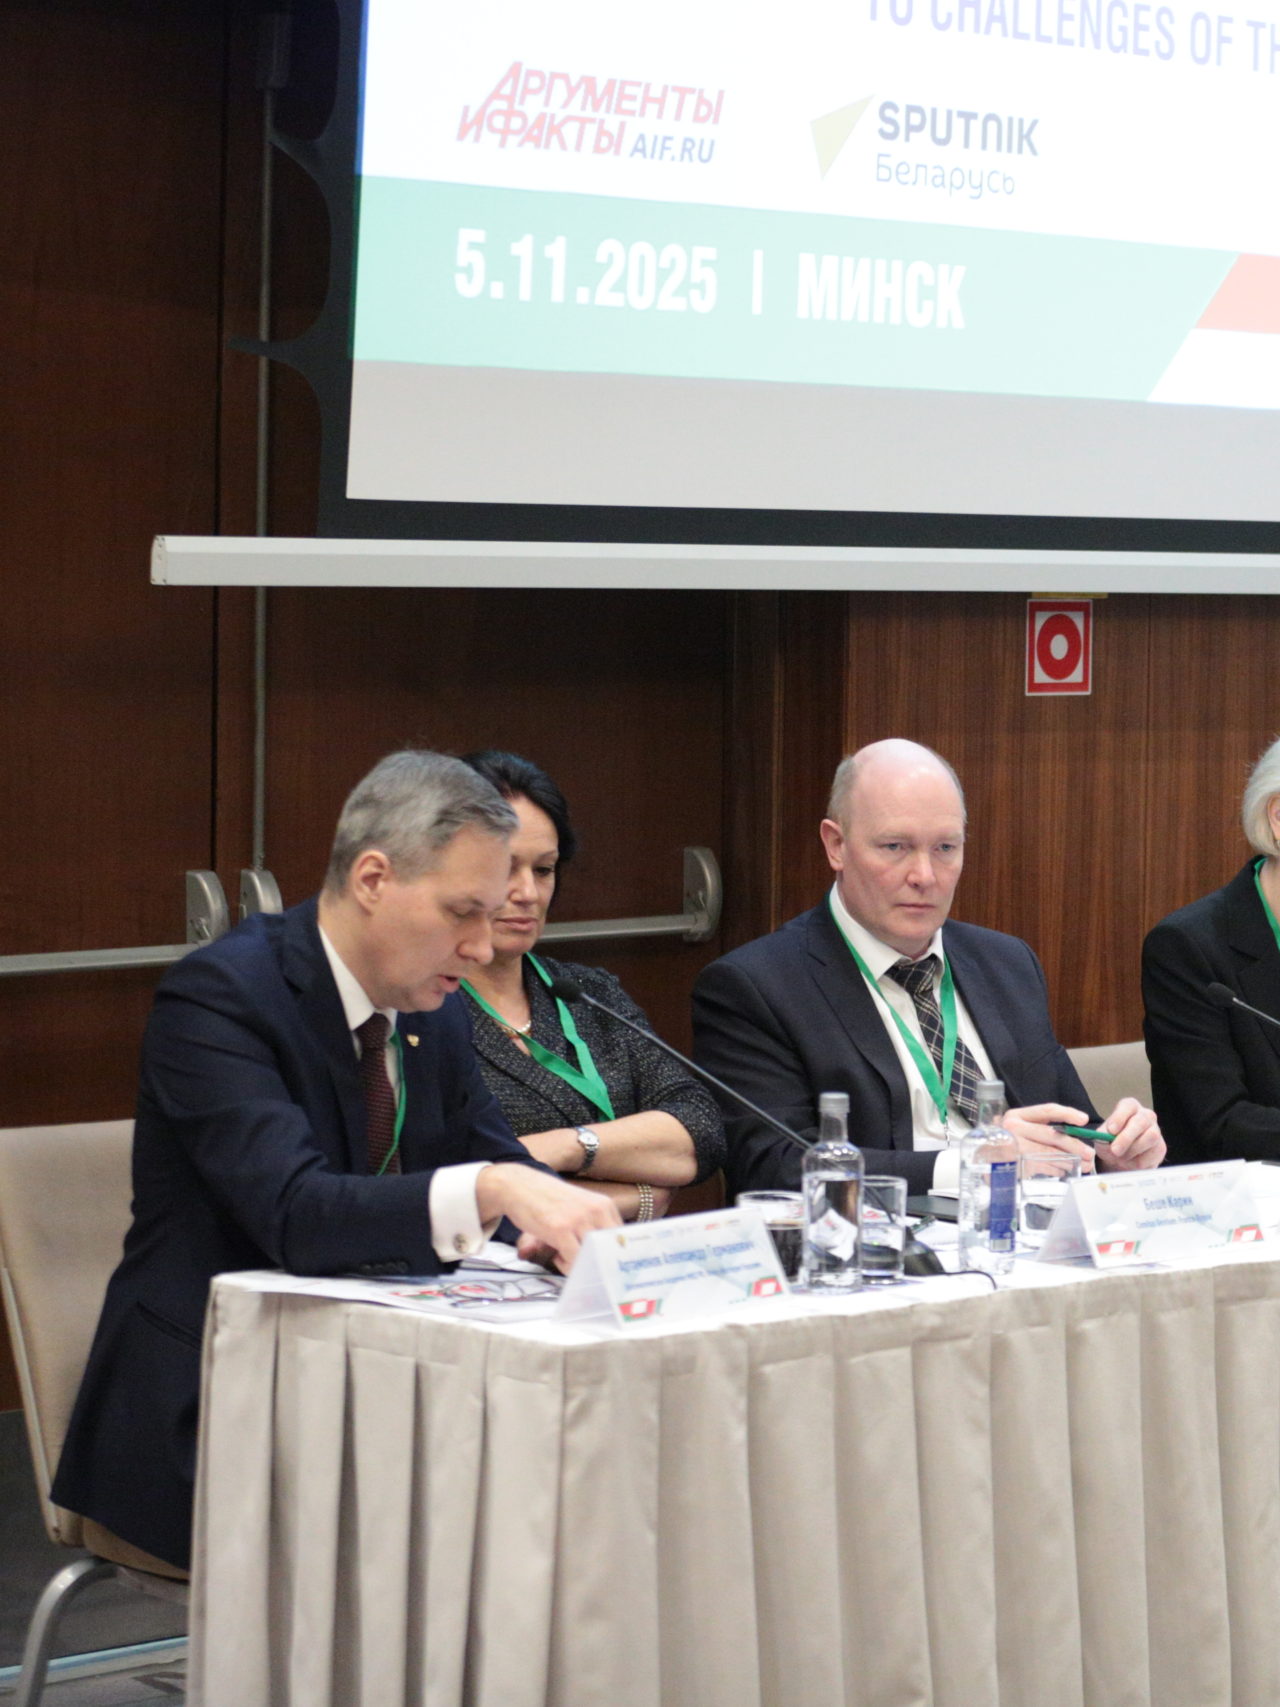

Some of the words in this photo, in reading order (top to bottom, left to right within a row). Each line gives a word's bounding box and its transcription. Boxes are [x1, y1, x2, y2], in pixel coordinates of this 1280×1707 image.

[930, 0, 1175, 61] CHALLENGES
[1190, 11, 1234, 66] OF
[484, 60, 726, 124] АРГУМЕНТЫ
[629, 132, 716, 164] AIF.RU
[877, 99, 1040, 157] SPUTNIK
[875, 152, 1016, 201] Беларусь
[453, 227, 719, 313] 5.11.2025
[796, 251, 967, 329] МИНСК
